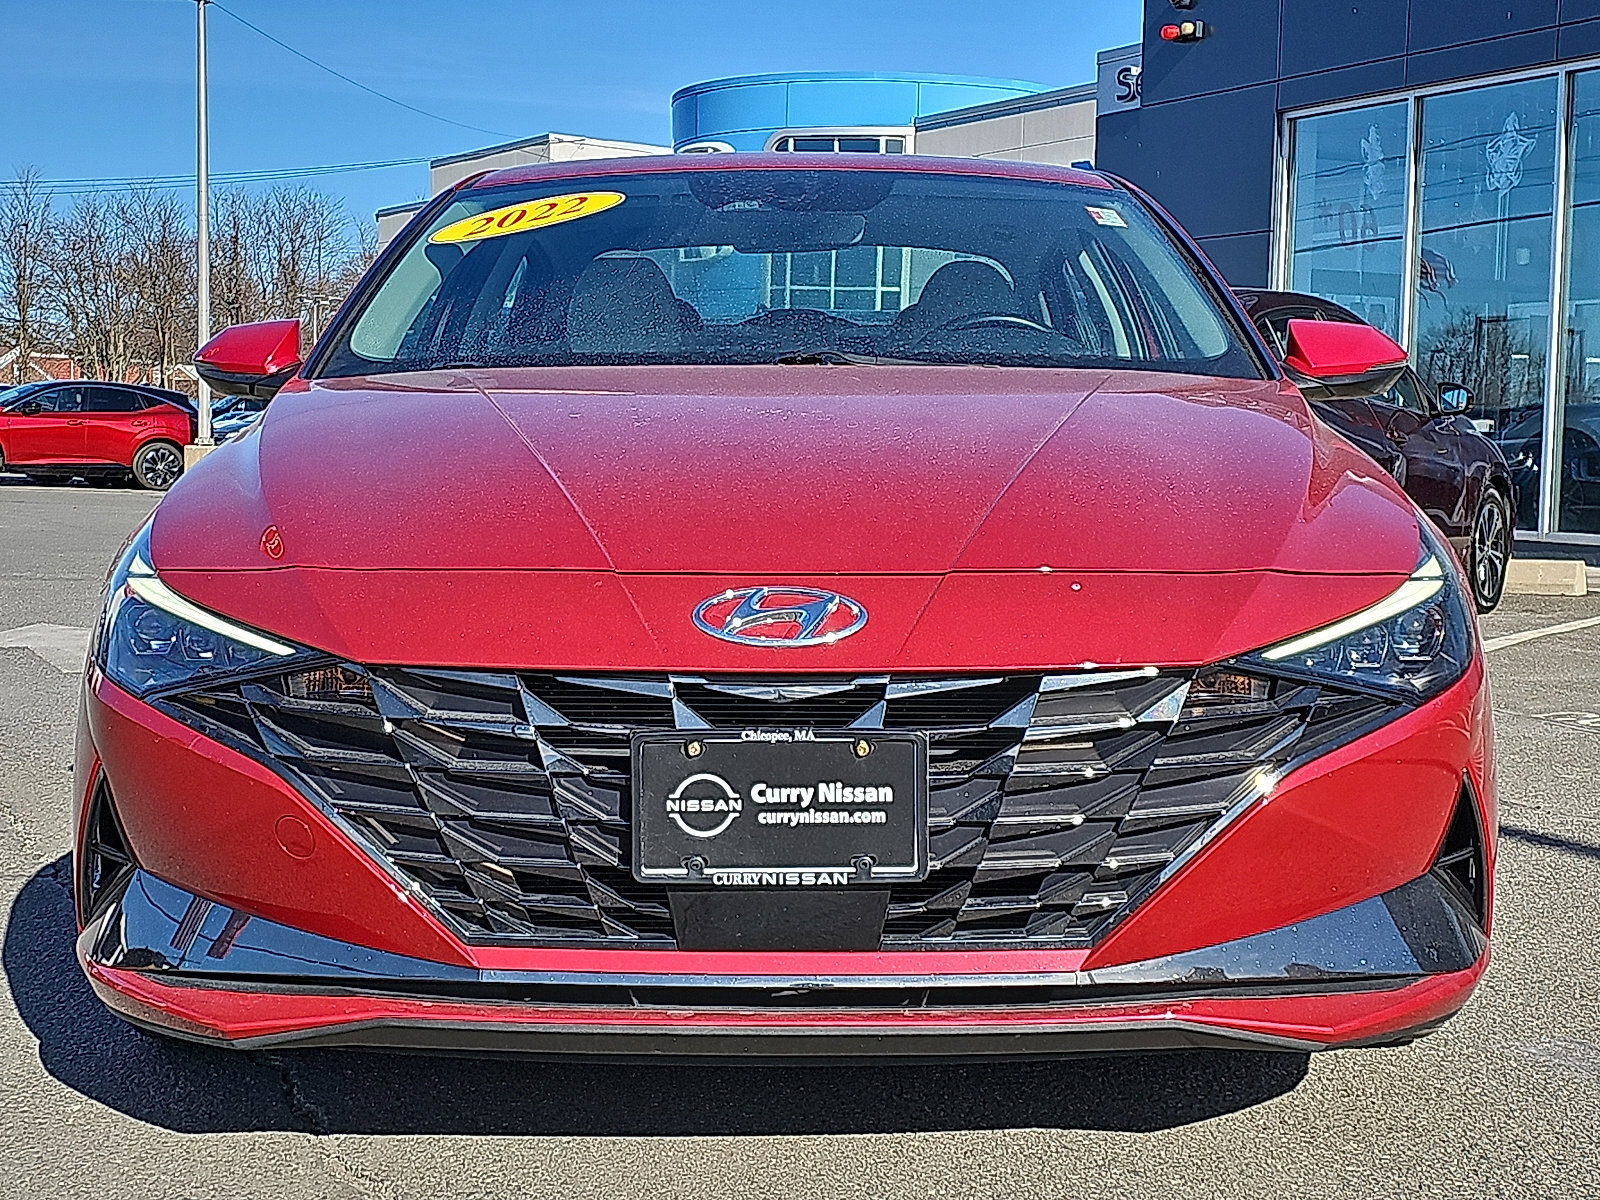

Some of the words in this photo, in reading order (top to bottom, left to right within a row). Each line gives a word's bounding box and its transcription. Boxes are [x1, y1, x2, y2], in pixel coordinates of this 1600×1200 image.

[463, 196, 588, 238] 2022
[741, 729, 793, 744] Chicopee,
[794, 728, 816, 741] MA
[750, 783, 815, 808] Curry
[818, 781, 894, 803] Nissan
[666, 799, 743, 812] NISSAN
[757, 807, 887, 827] currynissan.com
